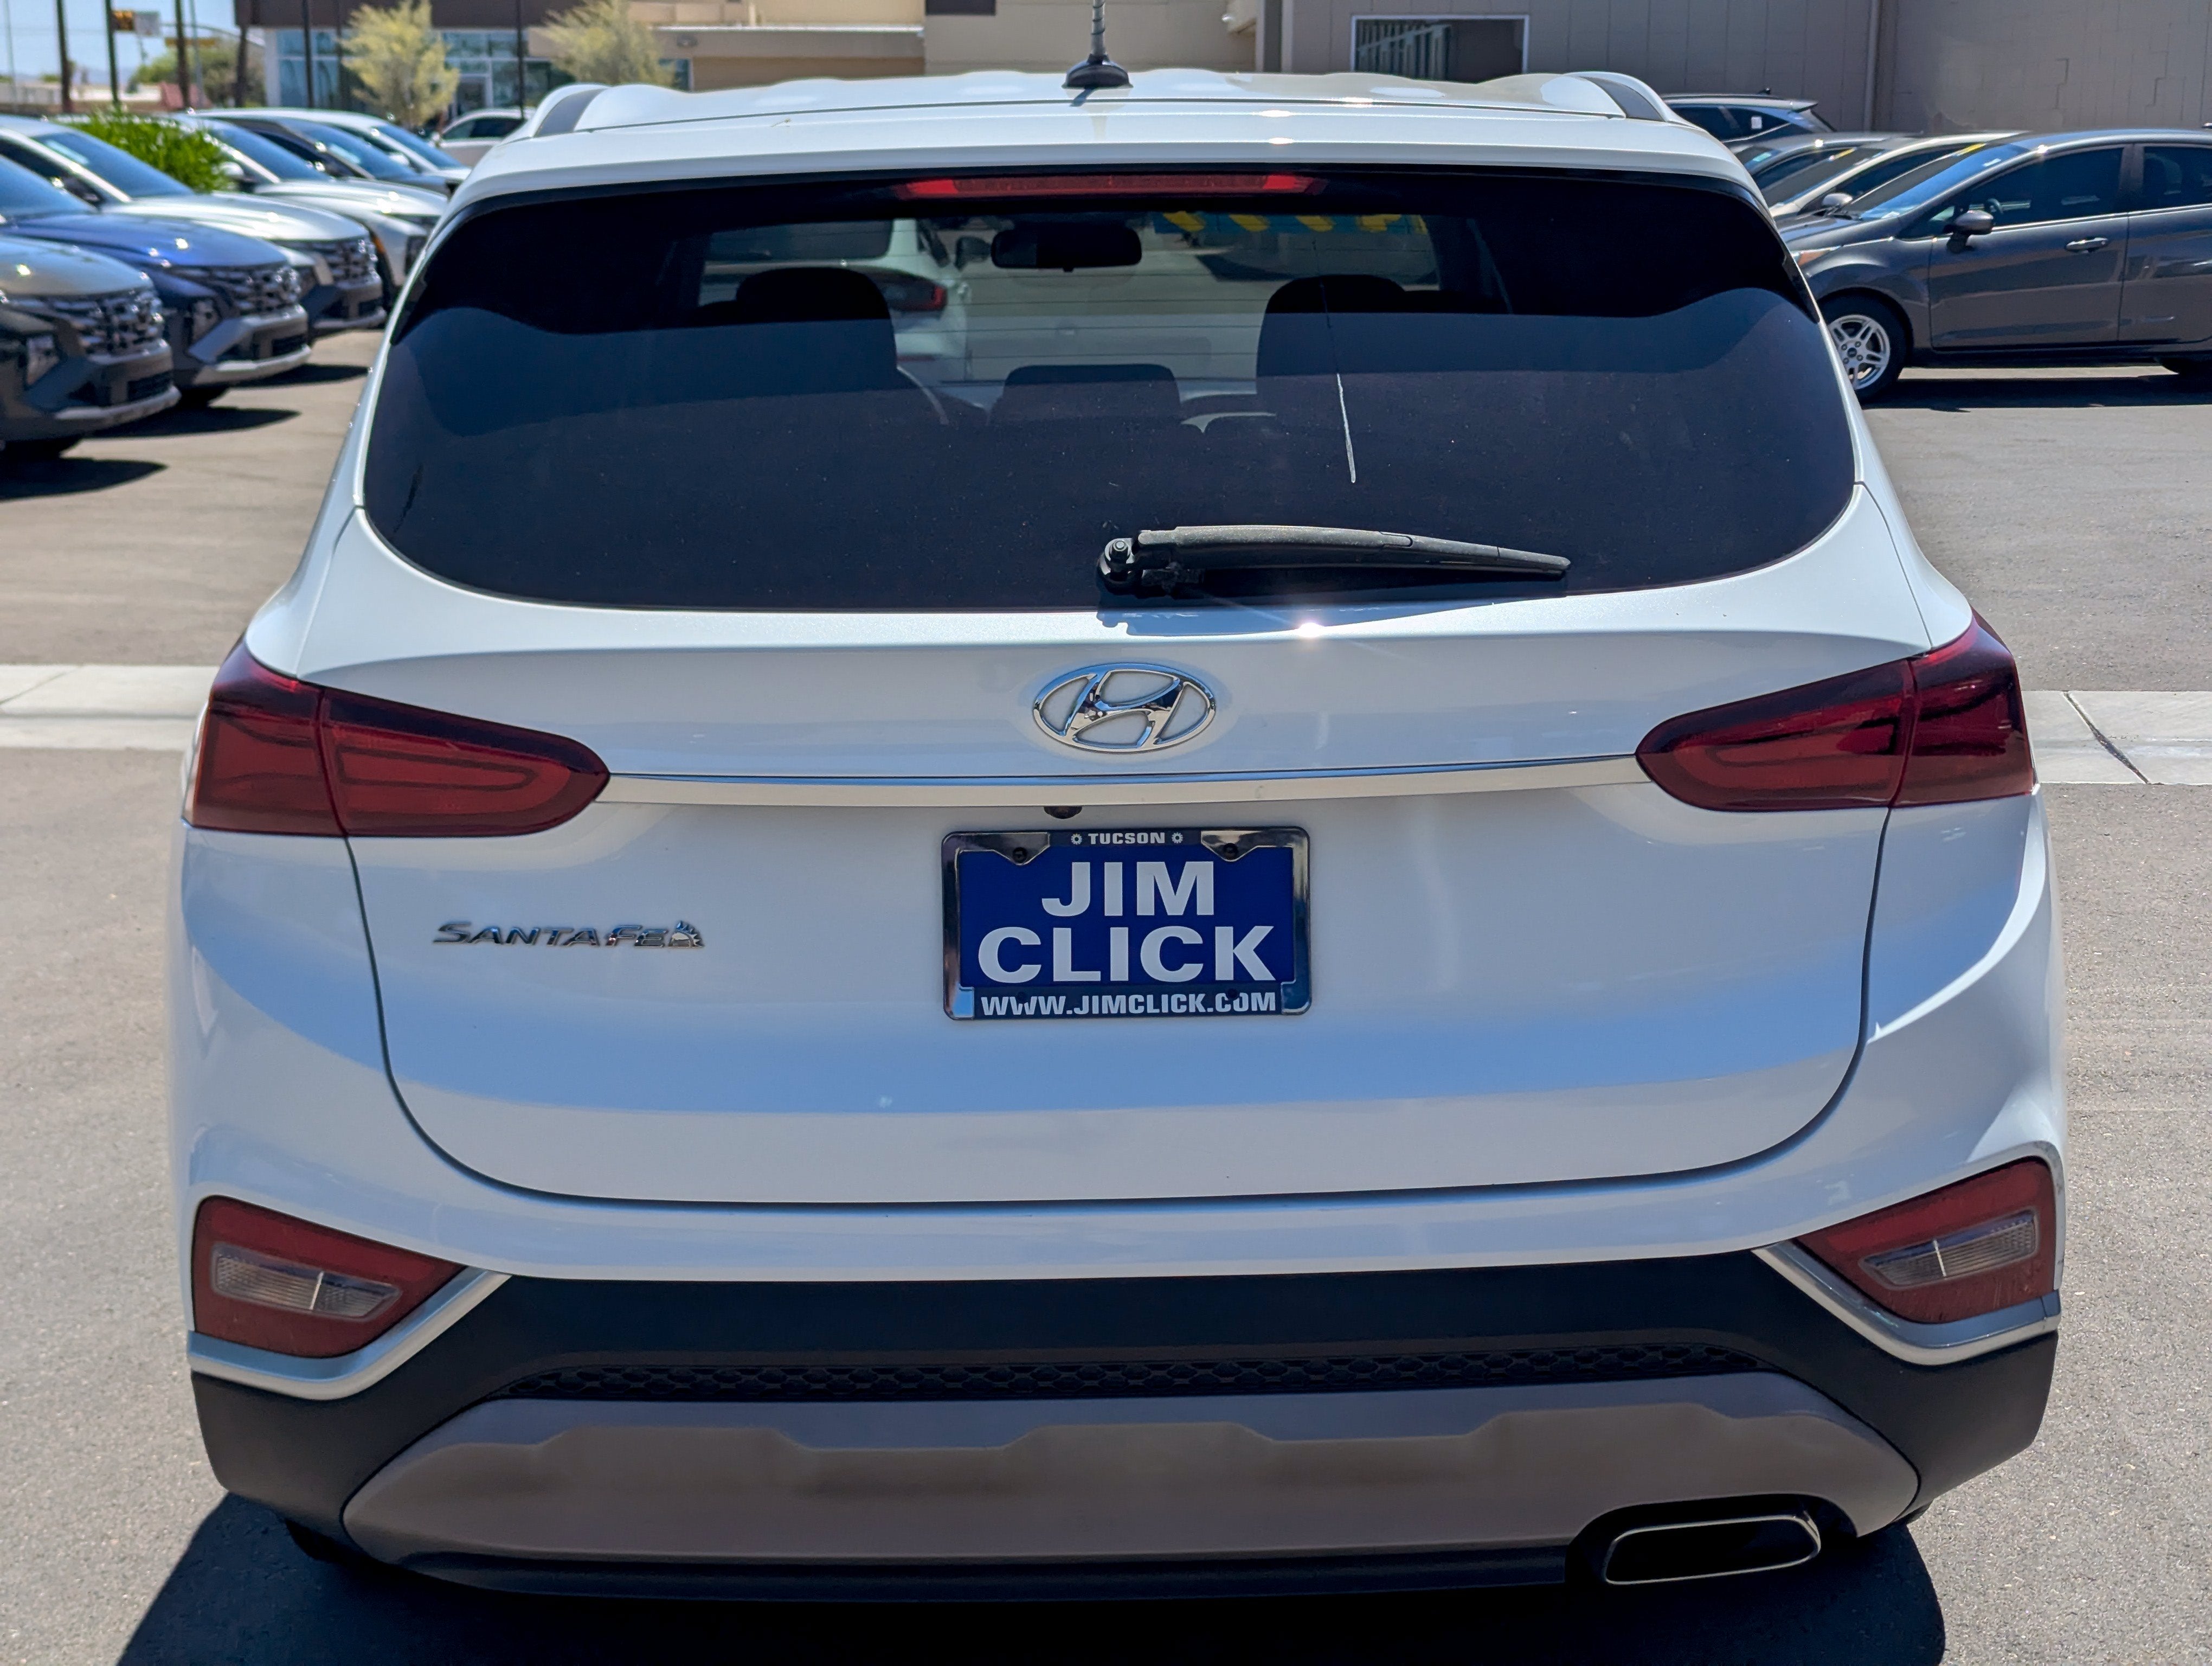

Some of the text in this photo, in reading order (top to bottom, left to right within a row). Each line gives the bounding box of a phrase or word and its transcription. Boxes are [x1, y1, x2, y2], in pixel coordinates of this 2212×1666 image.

[1088, 831, 1166, 845] TUCSON
[1041, 861, 1215, 917] JIM
[433, 921, 669, 947] SANTA FE
[978, 925, 1276, 983] CLICK
[980, 991, 1276, 1016] WWW.JIMCLICK.COM
